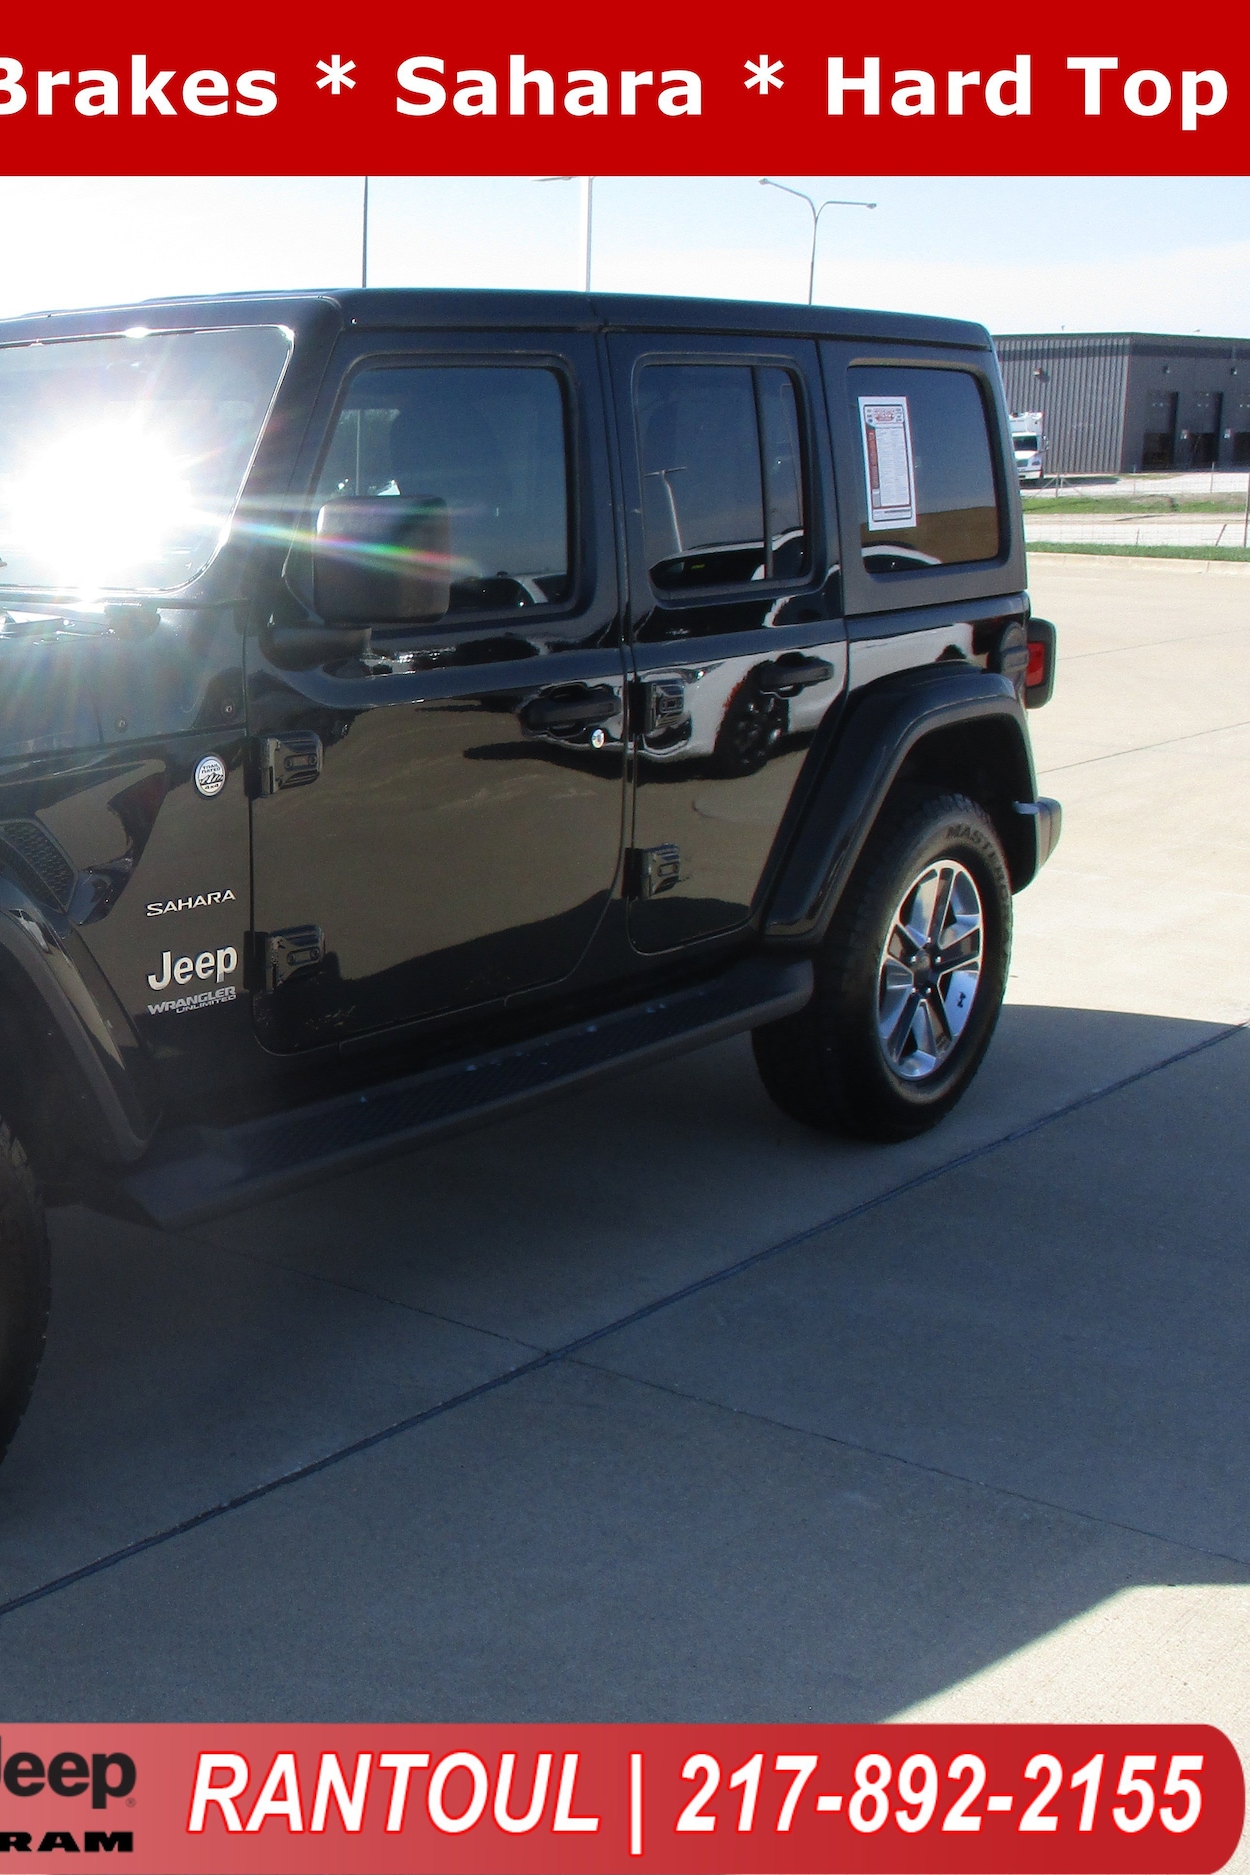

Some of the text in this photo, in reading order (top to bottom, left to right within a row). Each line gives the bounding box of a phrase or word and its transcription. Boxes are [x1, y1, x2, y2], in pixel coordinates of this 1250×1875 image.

[146, 889, 237, 917] SAHARA
[147, 946, 238, 991] Jeep
[147, 986, 237, 1015] WRANGLER
[175, 994, 237, 1014] UNLIMITED
